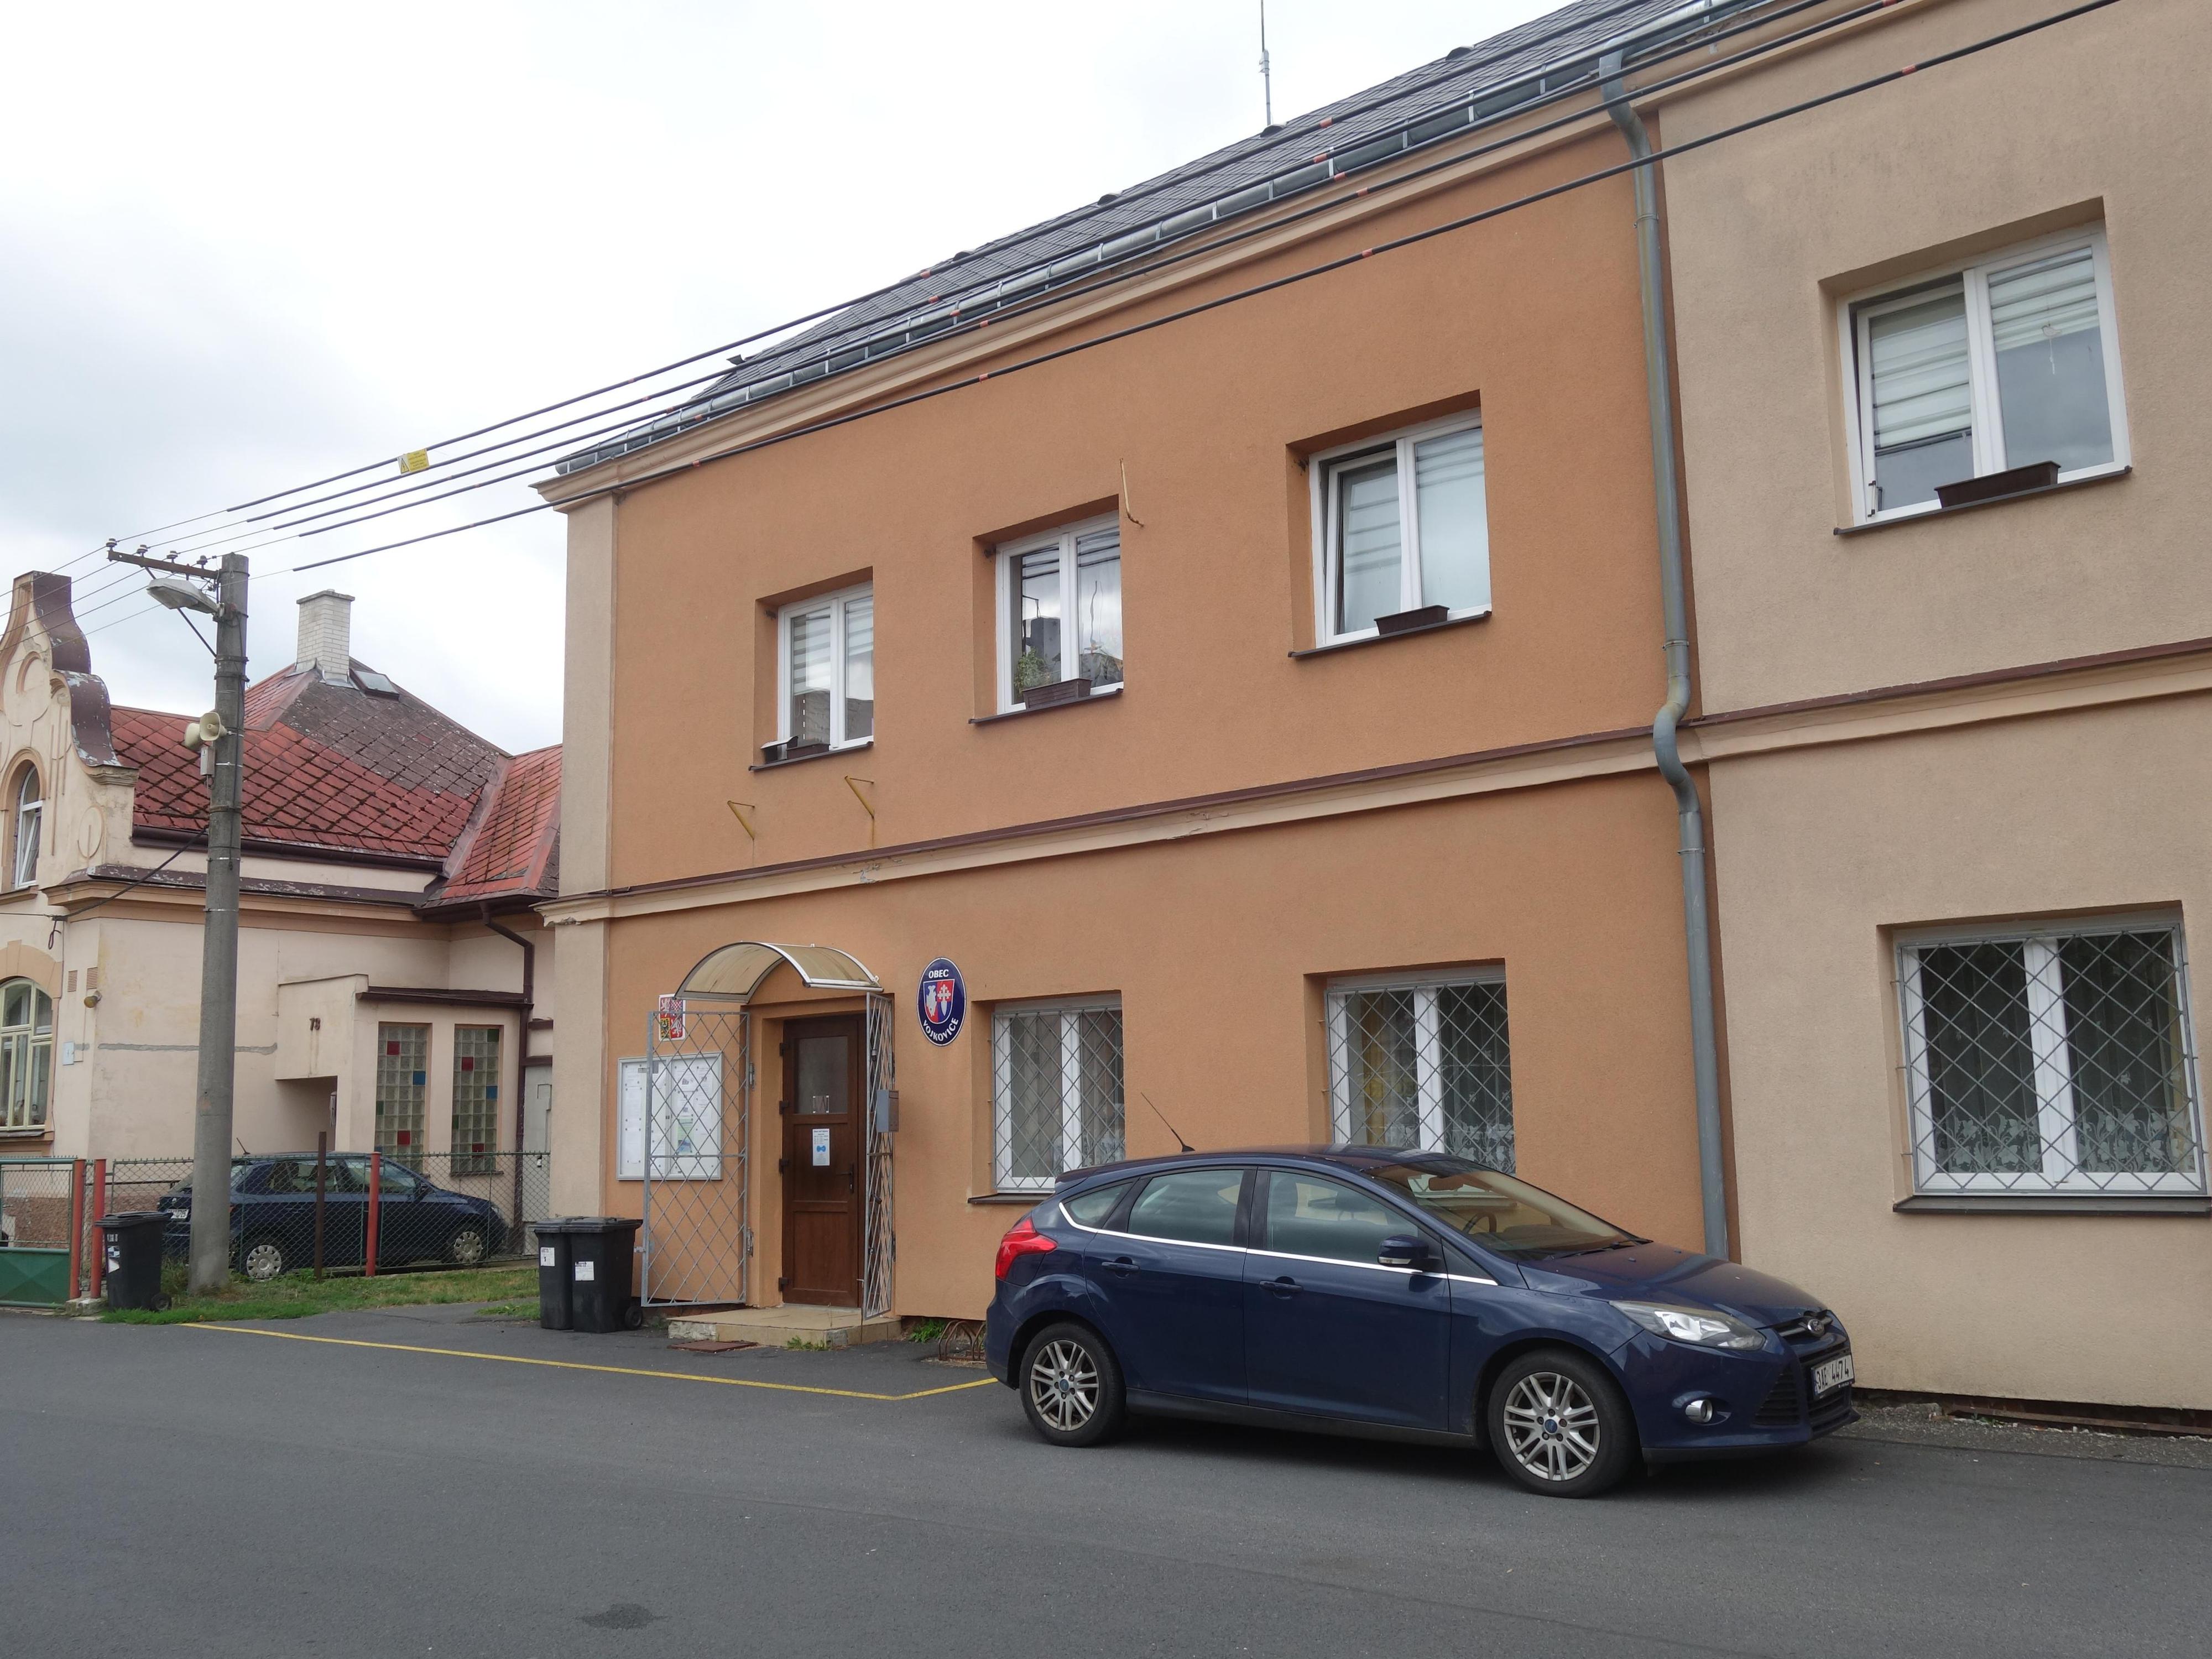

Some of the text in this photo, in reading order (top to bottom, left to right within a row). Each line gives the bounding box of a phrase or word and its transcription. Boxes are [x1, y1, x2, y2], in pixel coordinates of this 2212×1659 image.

[928, 969, 949, 979] OBEC
[922, 1017, 959, 1042] VOJKOVICE
[1815, 1358, 1849, 1390] 3AE 4474
